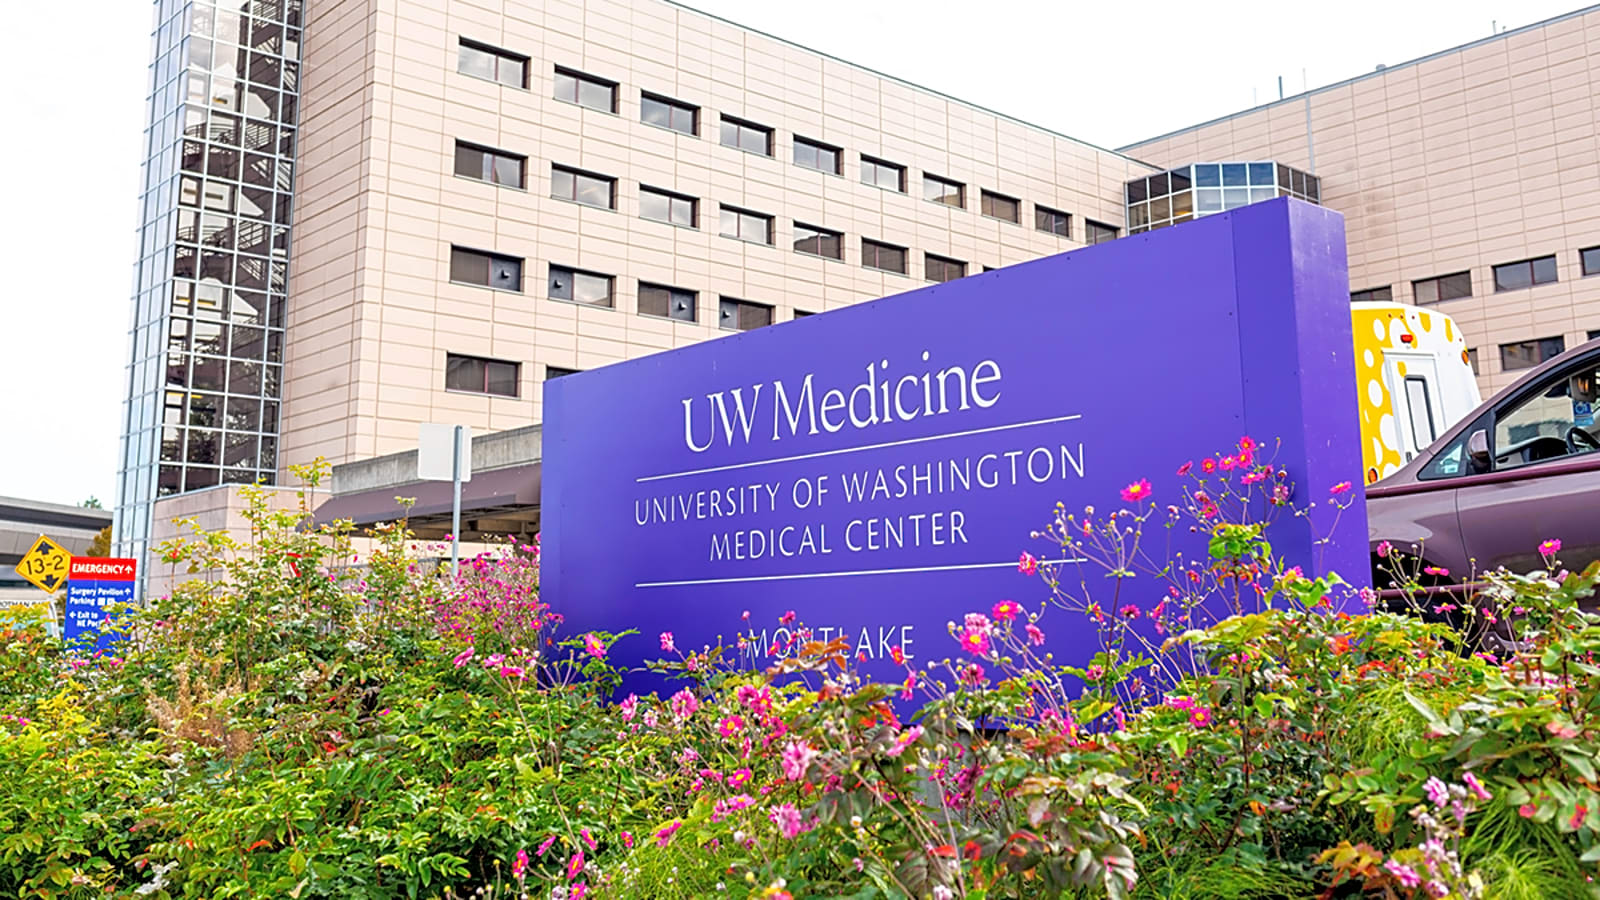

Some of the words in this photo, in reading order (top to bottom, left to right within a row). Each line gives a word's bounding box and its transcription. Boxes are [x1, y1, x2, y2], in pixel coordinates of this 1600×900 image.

[681, 383, 764, 453] UW
[771, 350, 1003, 441] Medicine
[634, 481, 782, 526] UNIVERSITY
[792, 475, 829, 509] OF
[841, 442, 1087, 503] WASHINGTON
[709, 523, 832, 562] MEDICAL
[845, 510, 969, 553] CENTER
[72, 563, 124, 574] EMERGENCY
[70, 587, 96, 596] Surgery
[98, 587, 124, 596] Pavilion
[70, 597, 96, 606] Parking
[745, 625, 915, 659] MONTLAKE
